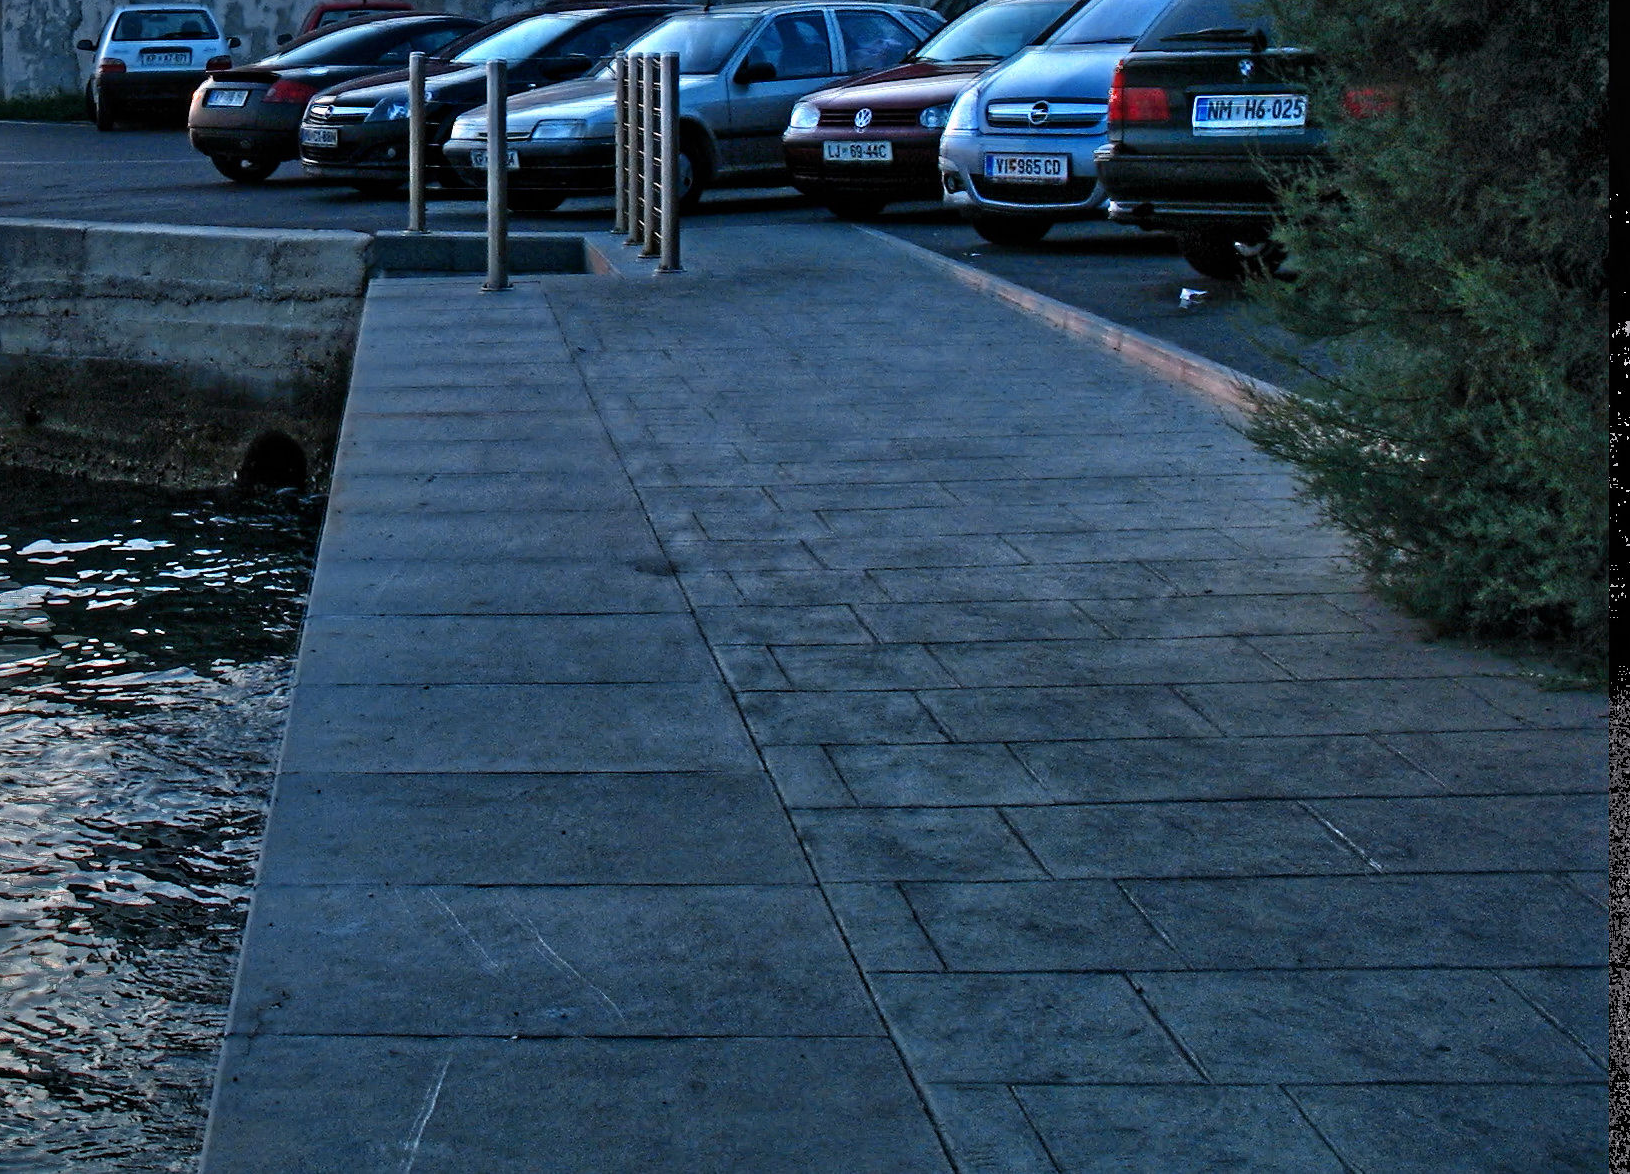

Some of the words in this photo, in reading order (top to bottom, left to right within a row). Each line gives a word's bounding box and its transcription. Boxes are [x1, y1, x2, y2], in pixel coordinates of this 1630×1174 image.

[1207, 100, 1233, 120] NM
[827, 144, 840, 158] LJ
[995, 158, 1008, 175] VI
[1017, 158, 1042, 175] 965
